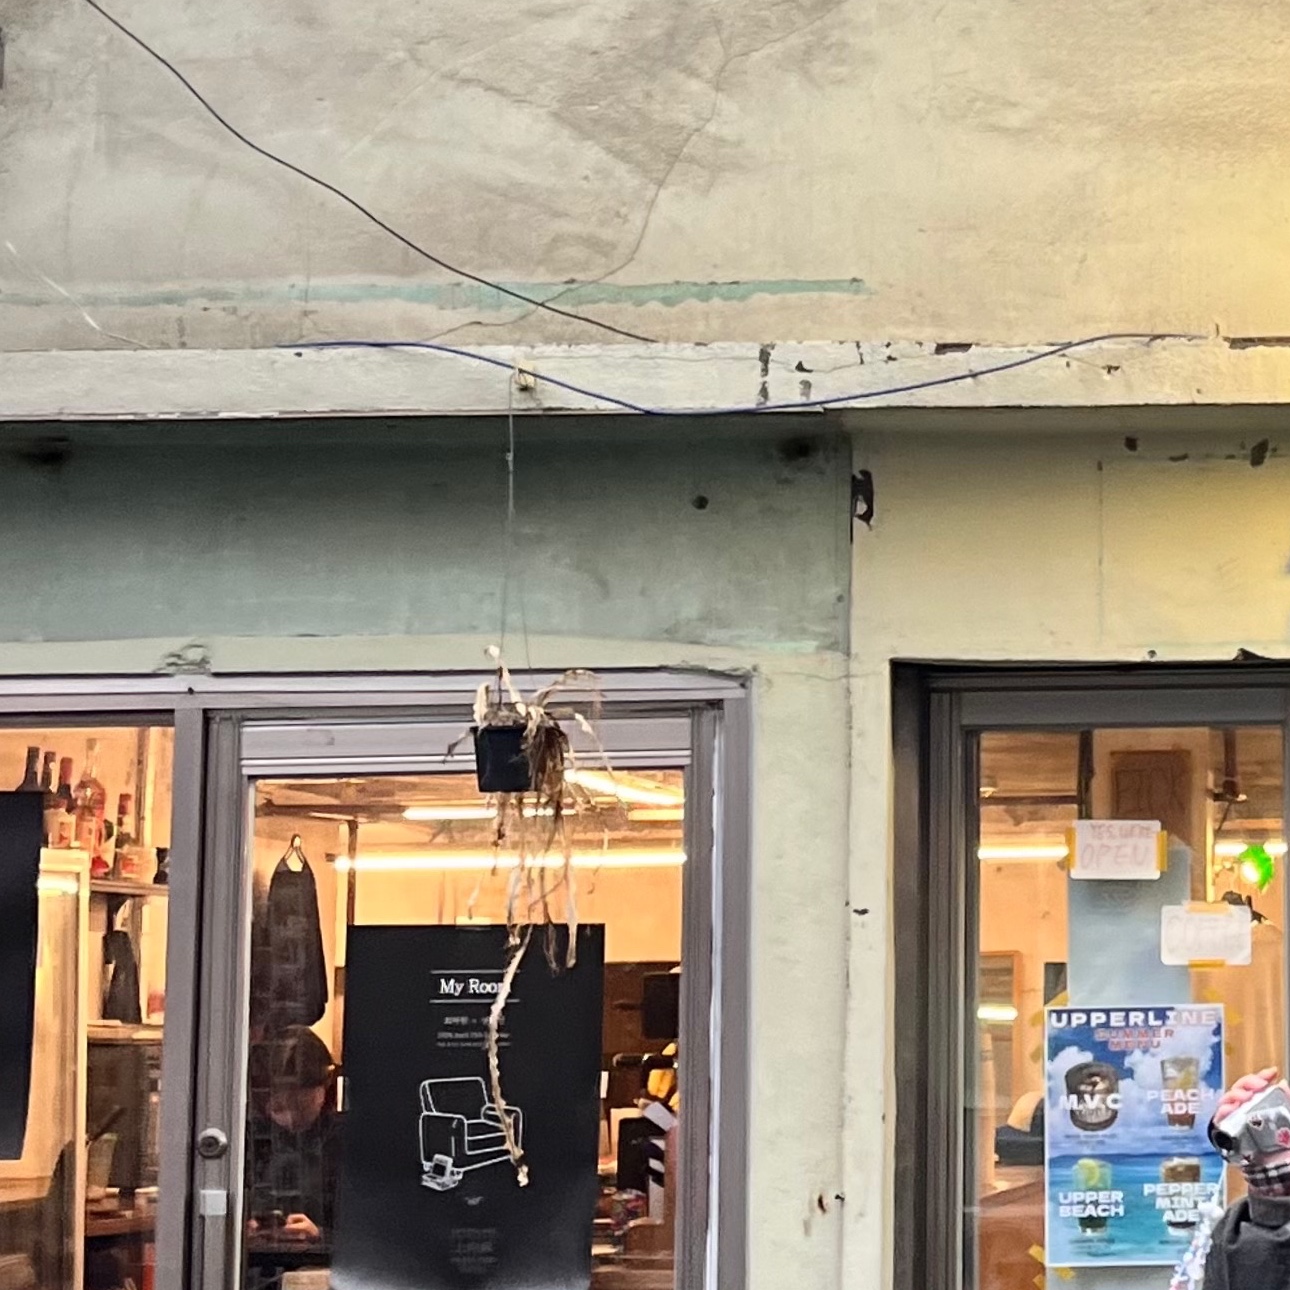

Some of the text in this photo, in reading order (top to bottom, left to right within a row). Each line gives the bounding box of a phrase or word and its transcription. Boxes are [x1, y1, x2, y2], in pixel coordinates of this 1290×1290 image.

[439, 978, 464, 996] My
[1050, 1010, 1217, 1028] UPPERLINE
[1095, 1028, 1175, 1040] SUMMER
[1109, 1040, 1161, 1050] MENU
[1147, 1089, 1214, 1101] PEACH
[1161, 1102, 1200, 1114] ADE
[1143, 1183, 1219, 1196] PEPPER
[1059, 1190, 1124, 1203] UPPER
[1059, 1204, 1125, 1217] BEACH
[1163, 1209, 1201, 1222] ADE
